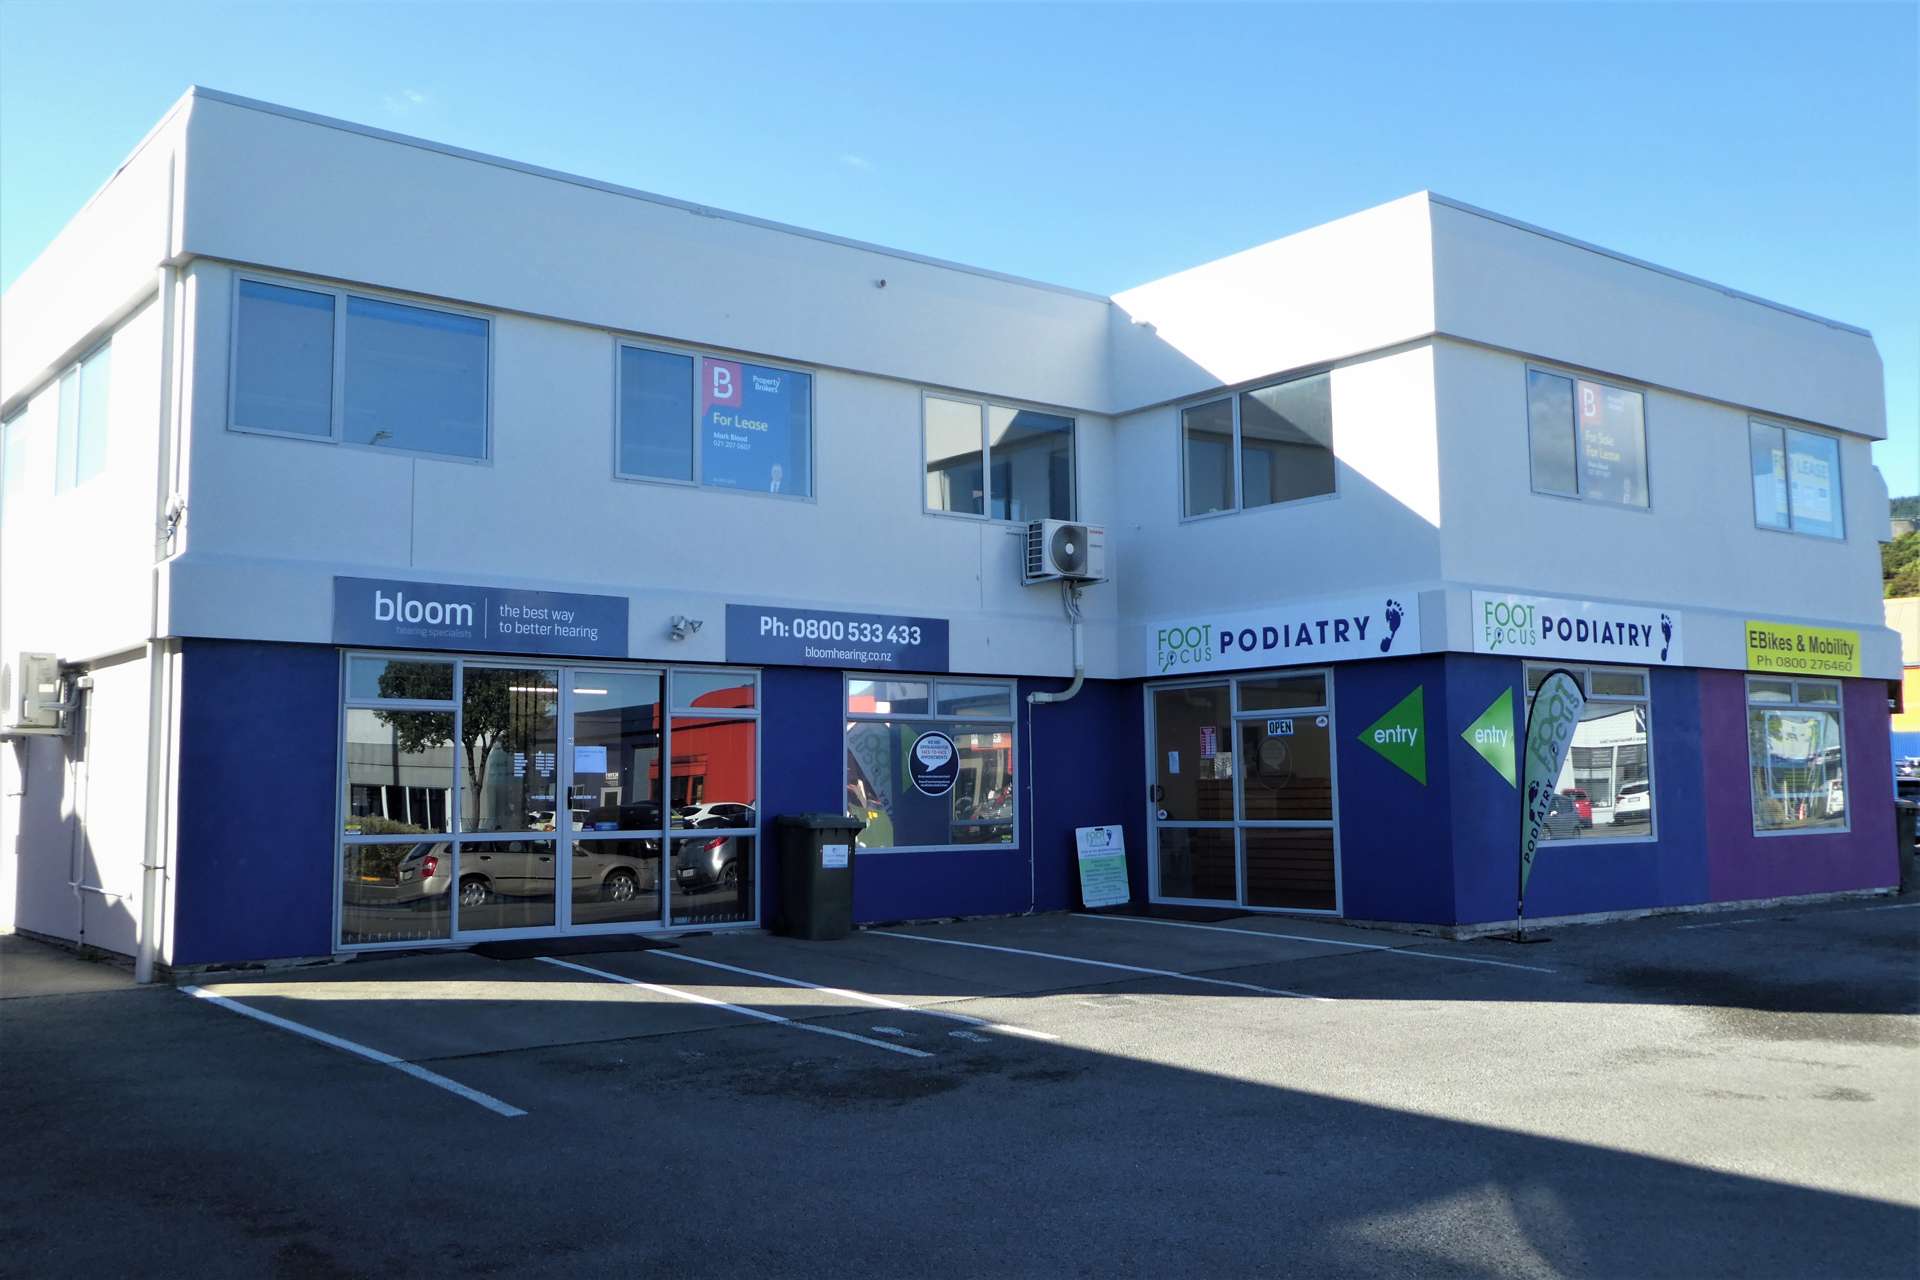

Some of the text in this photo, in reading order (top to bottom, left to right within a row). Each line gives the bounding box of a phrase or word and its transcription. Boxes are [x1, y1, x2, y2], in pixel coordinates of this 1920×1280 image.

[752, 375, 780, 388] Property
[713, 412, 768, 431] For Lease
[375, 590, 472, 626] bloom
[500, 605, 574, 623] the best way
[1484, 601, 1535, 628] FOOT
[499, 622, 598, 641] to better hearing
[760, 616, 921, 645] Ph: 0800 533 433
[1158, 624, 1212, 650] FOOT
[1220, 616, 1370, 654] PODIATRY
[1486, 626, 1536, 650] FOCUS
[1541, 615, 1652, 647] PODIATRY
[805, 646, 892, 663] bloomhearing.co.nz
[1749, 630, 1854, 660] EBikes & Mobility
[1158, 647, 1212, 672] FOCUS
[1757, 655, 1853, 672] Ph 0800 276460
[1269, 720, 1292, 734] OPEN
[1530, 677, 1569, 758] FOOT
[1374, 724, 1418, 746] entry
[1475, 725, 1508, 747] entry
[1524, 778, 1554, 864] PODIATRY
